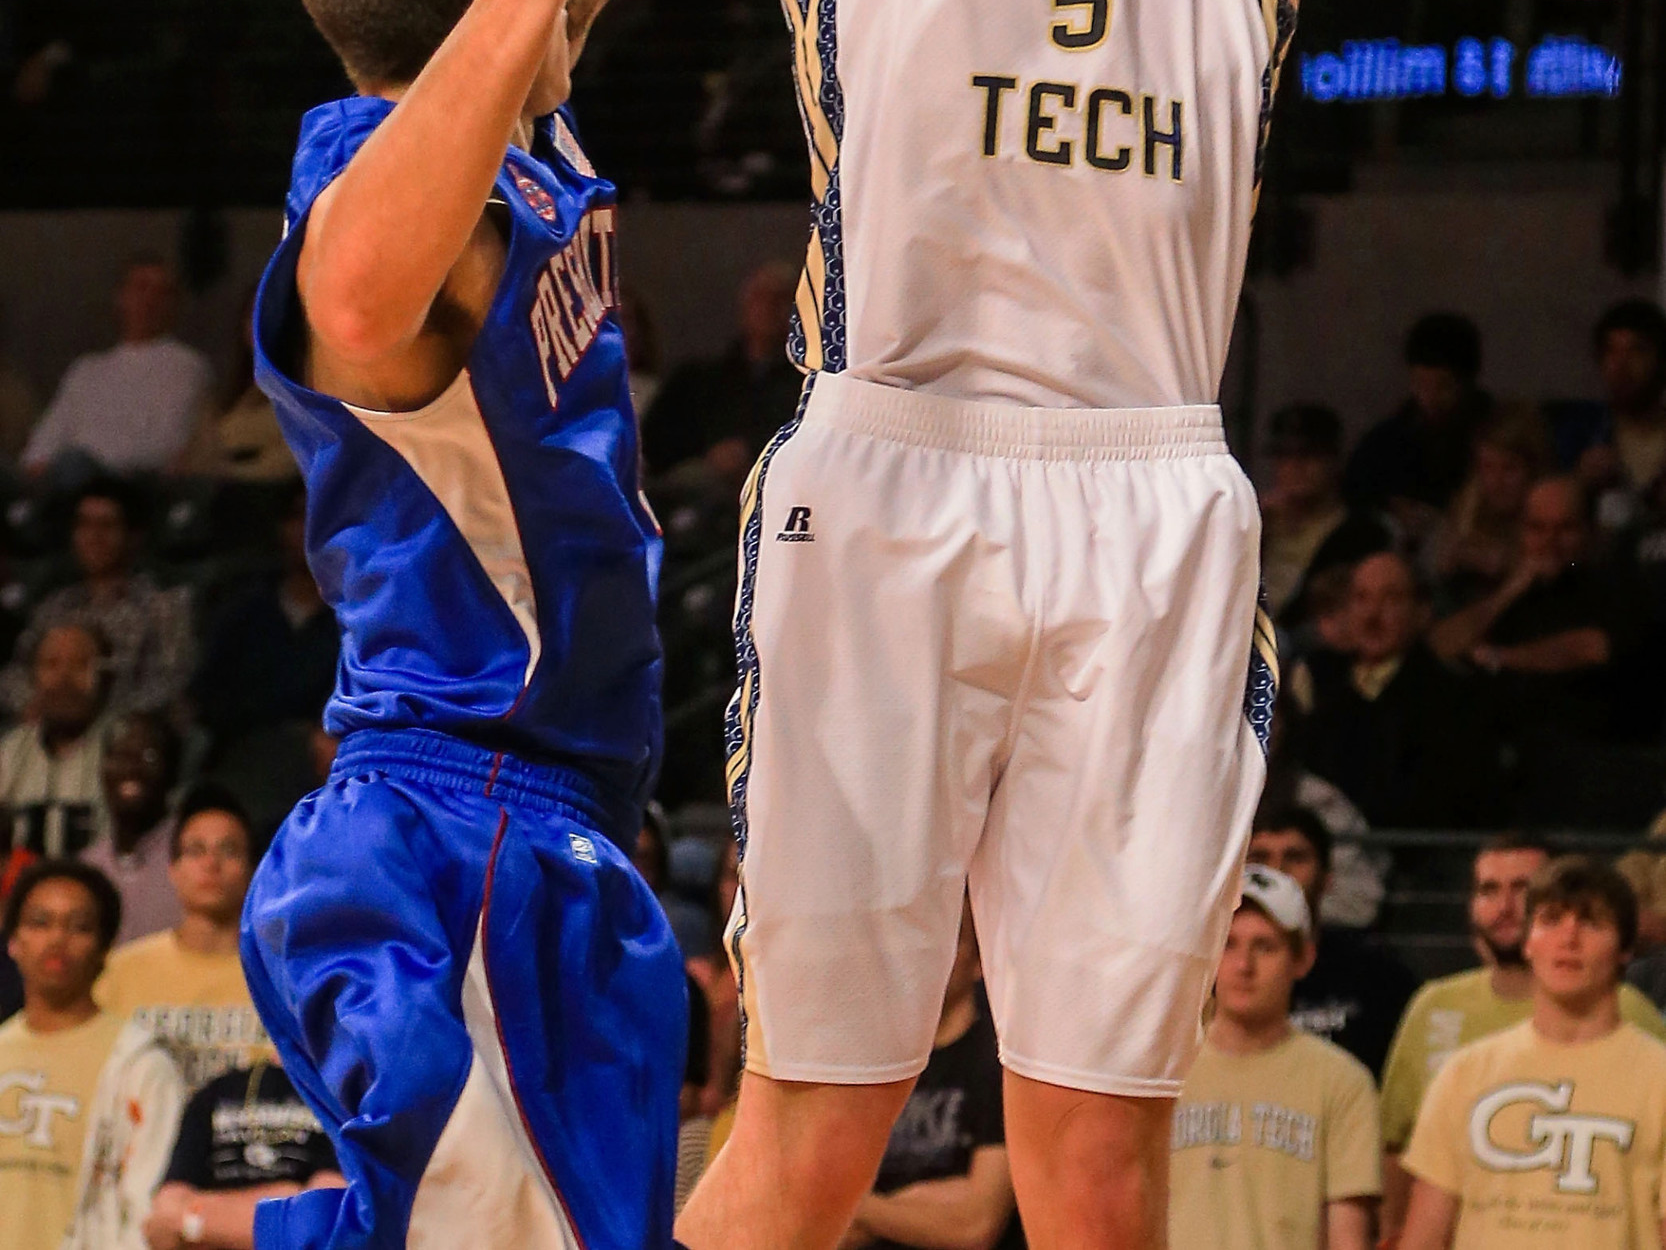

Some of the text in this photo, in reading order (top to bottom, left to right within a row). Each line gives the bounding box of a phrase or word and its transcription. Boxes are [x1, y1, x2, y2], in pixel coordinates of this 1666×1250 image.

[970, 72, 1184, 184] TECH
[784, 506, 811, 532] R
[1468, 1078, 1636, 1193] GT
